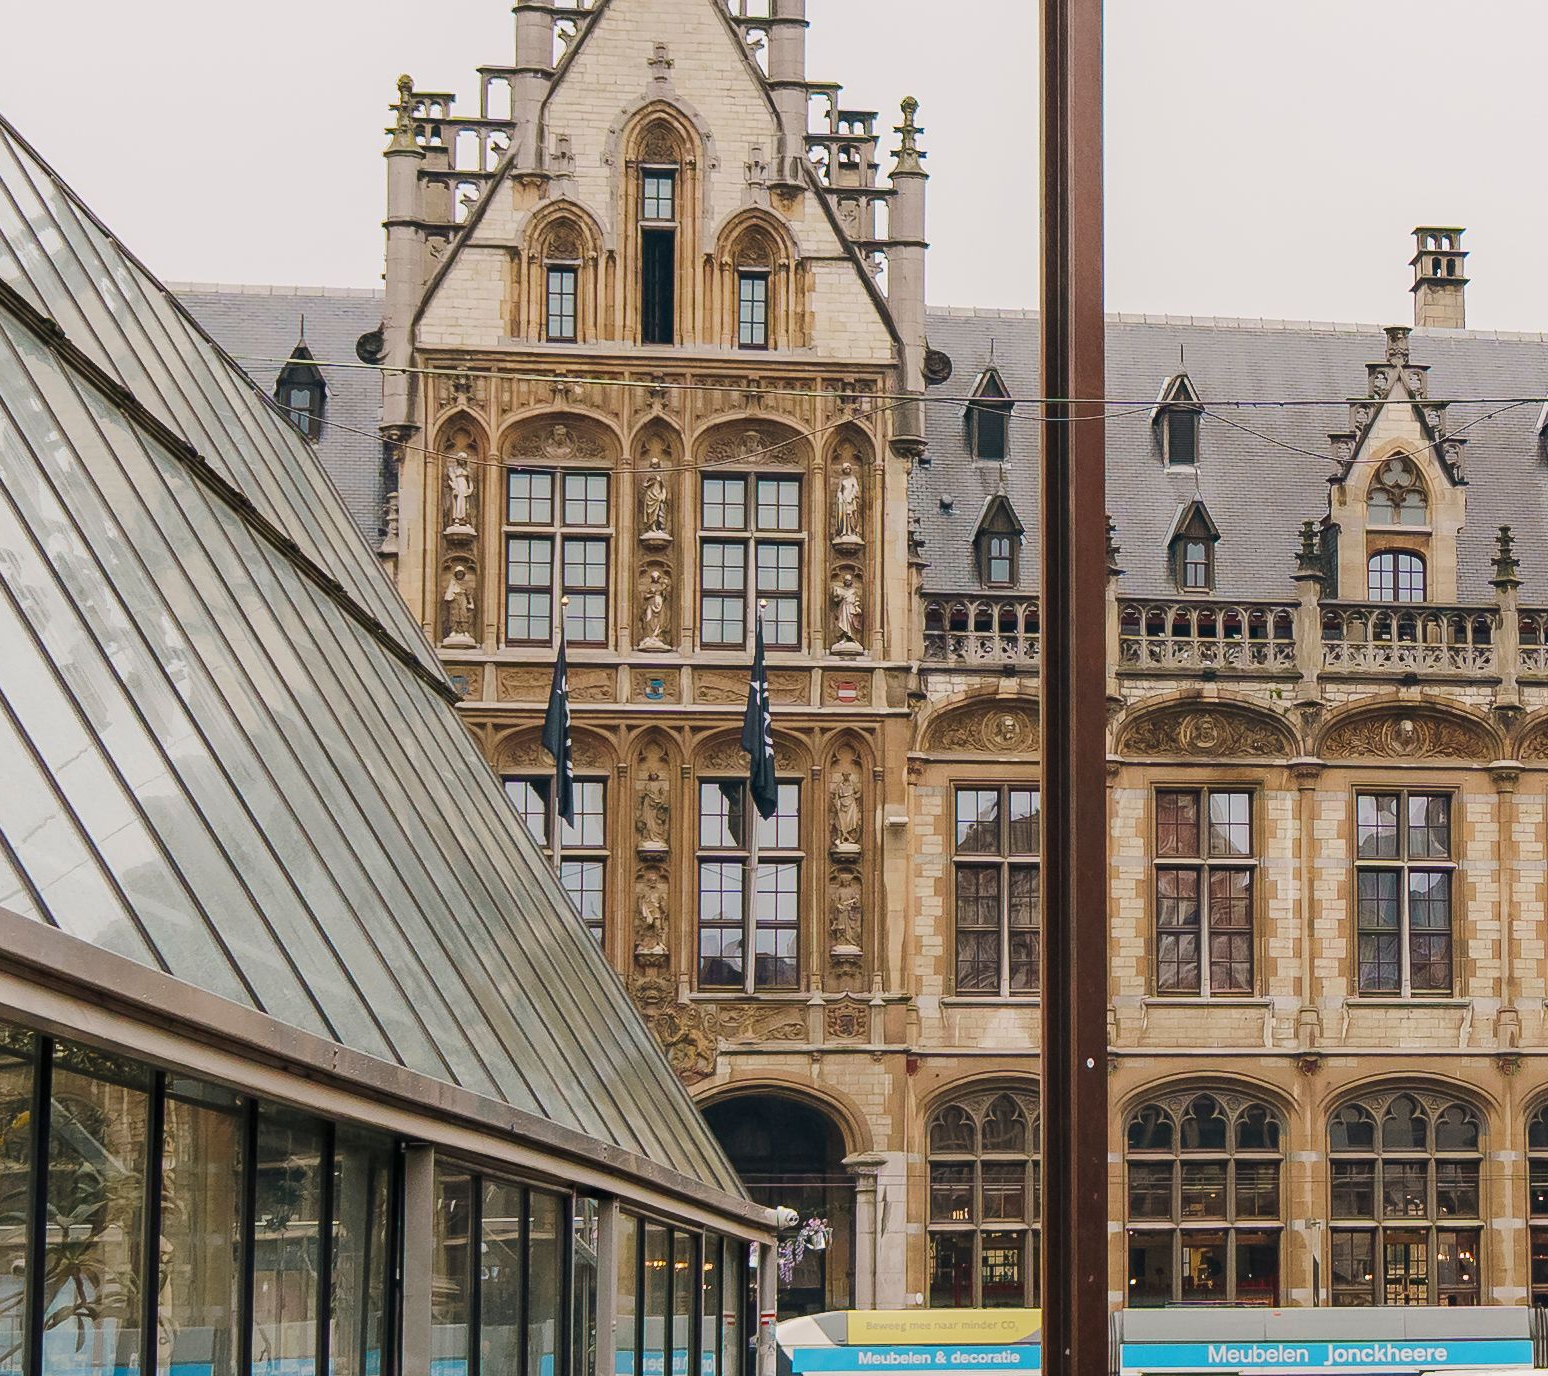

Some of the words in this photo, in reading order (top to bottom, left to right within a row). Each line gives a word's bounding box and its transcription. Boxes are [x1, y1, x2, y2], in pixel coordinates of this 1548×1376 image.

[866, 1320, 906, 1332] Beweeg
[910, 1322, 932, 1330] mee
[935, 1321, 958, 1330] naar
[961, 1320, 999, 1330] minder
[857, 1351, 932, 1366] Meubelen
[934, 1350, 948, 1365] &
[950, 1350, 1021, 1365] decoratie
[1207, 1344, 1309, 1364] Meubelen
[1323, 1342, 1448, 1367] Jonckheere
